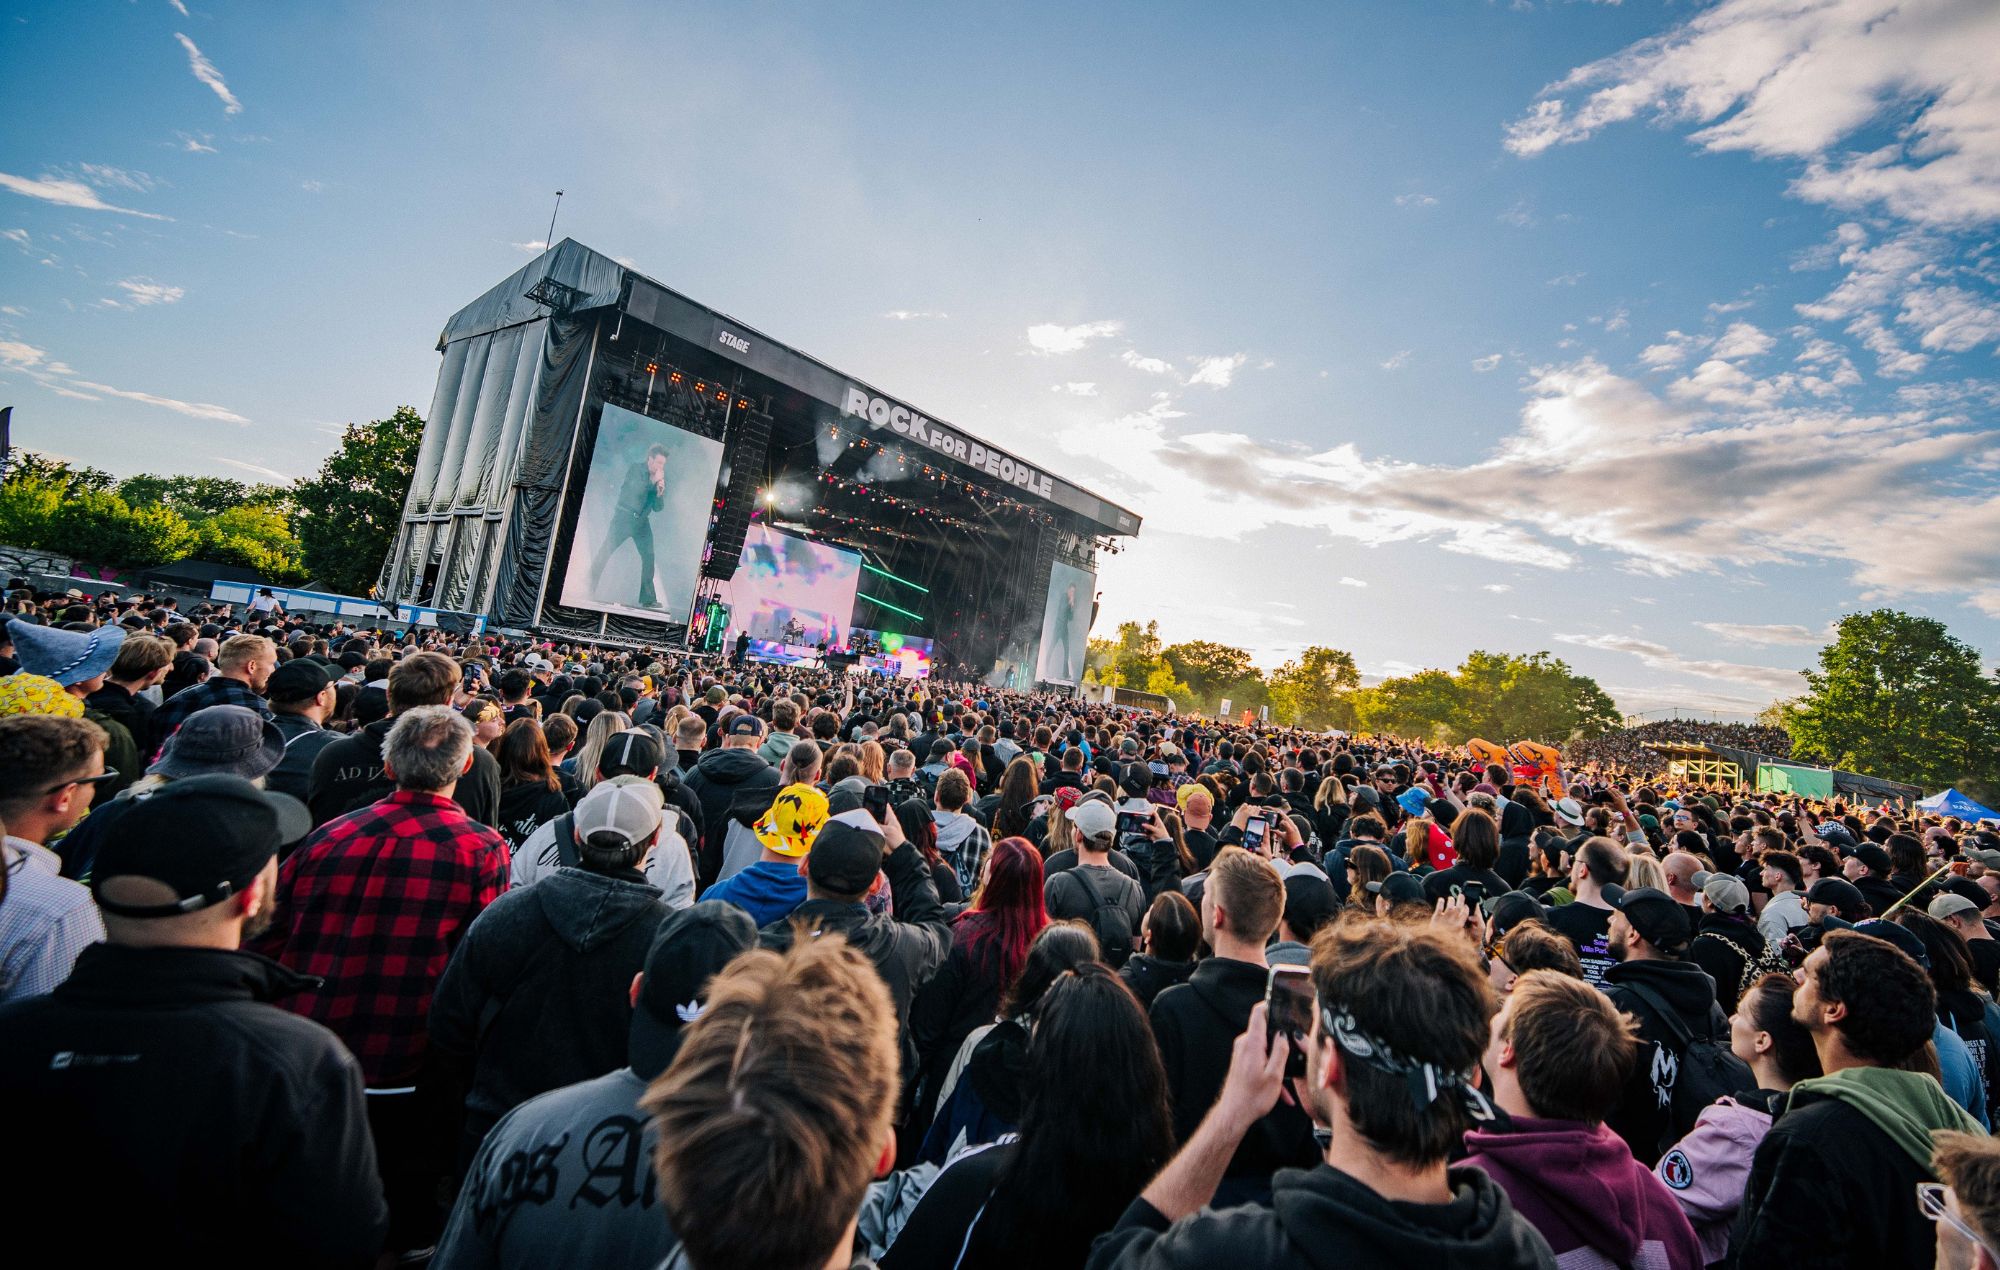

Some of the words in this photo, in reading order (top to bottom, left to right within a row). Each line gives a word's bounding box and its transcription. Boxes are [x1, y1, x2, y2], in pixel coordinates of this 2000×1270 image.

[719, 330, 751, 354] STAGE
[847, 387, 929, 442] ROCK
[929, 429, 967, 460] FOR
[968, 442, 1053, 500] PEOPLE
[334, 766, 362, 781] AD
